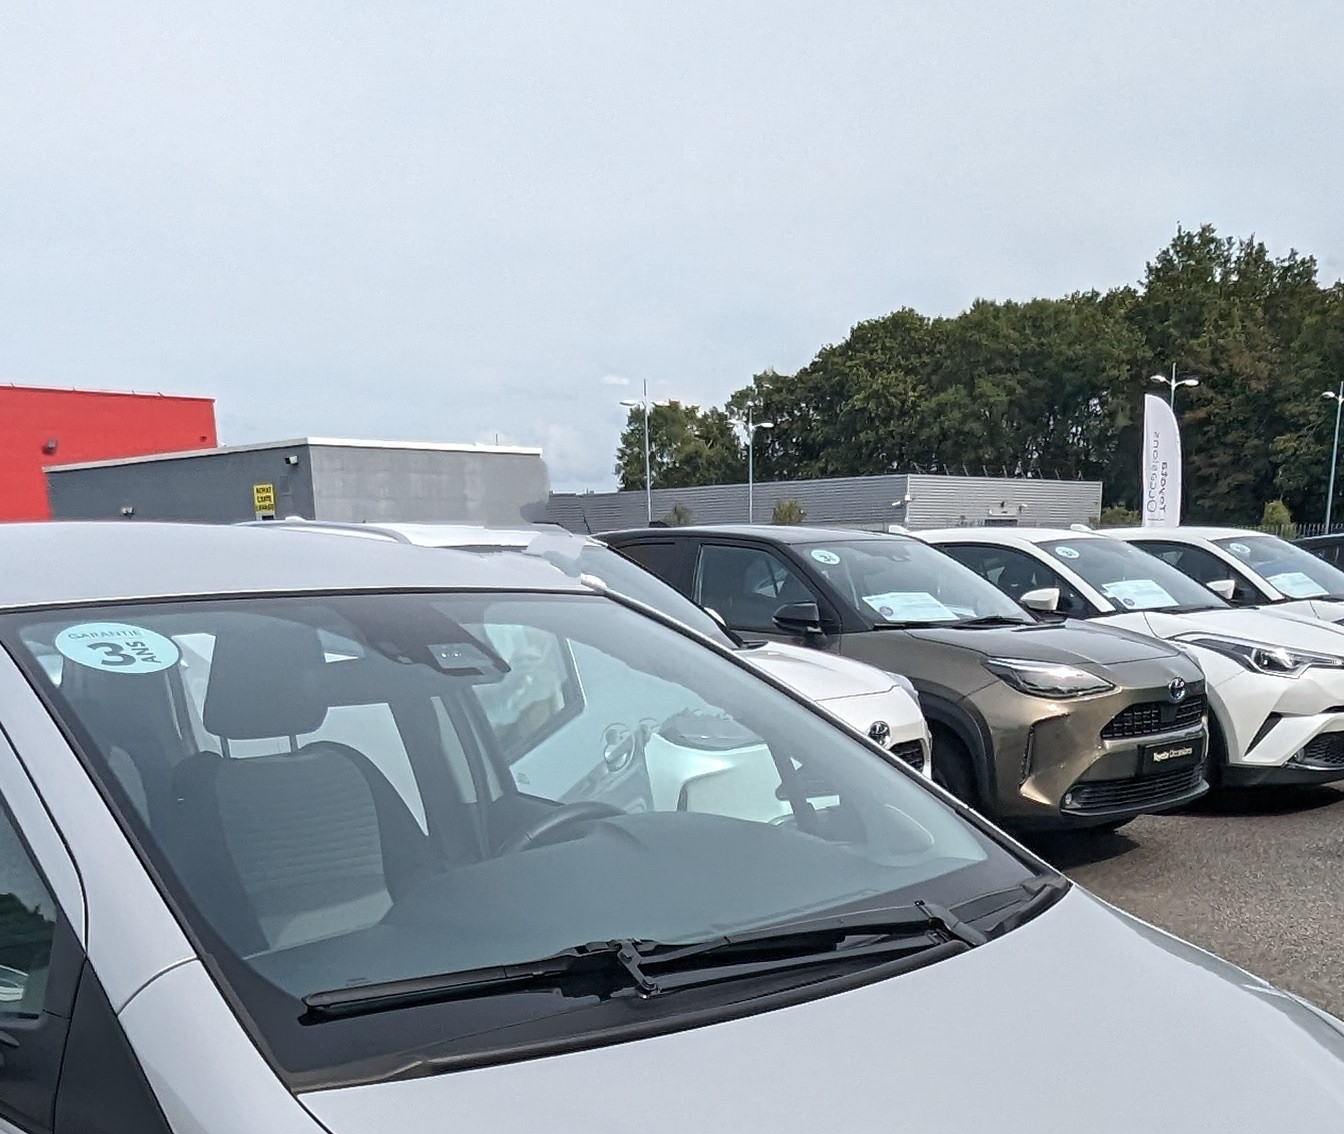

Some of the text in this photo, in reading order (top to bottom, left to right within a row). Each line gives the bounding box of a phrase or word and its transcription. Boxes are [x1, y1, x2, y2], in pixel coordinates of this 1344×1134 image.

[67, 629, 143, 640] GARANTIE
[87, 641, 136, 667] 3
[125, 640, 162, 664] ANS
